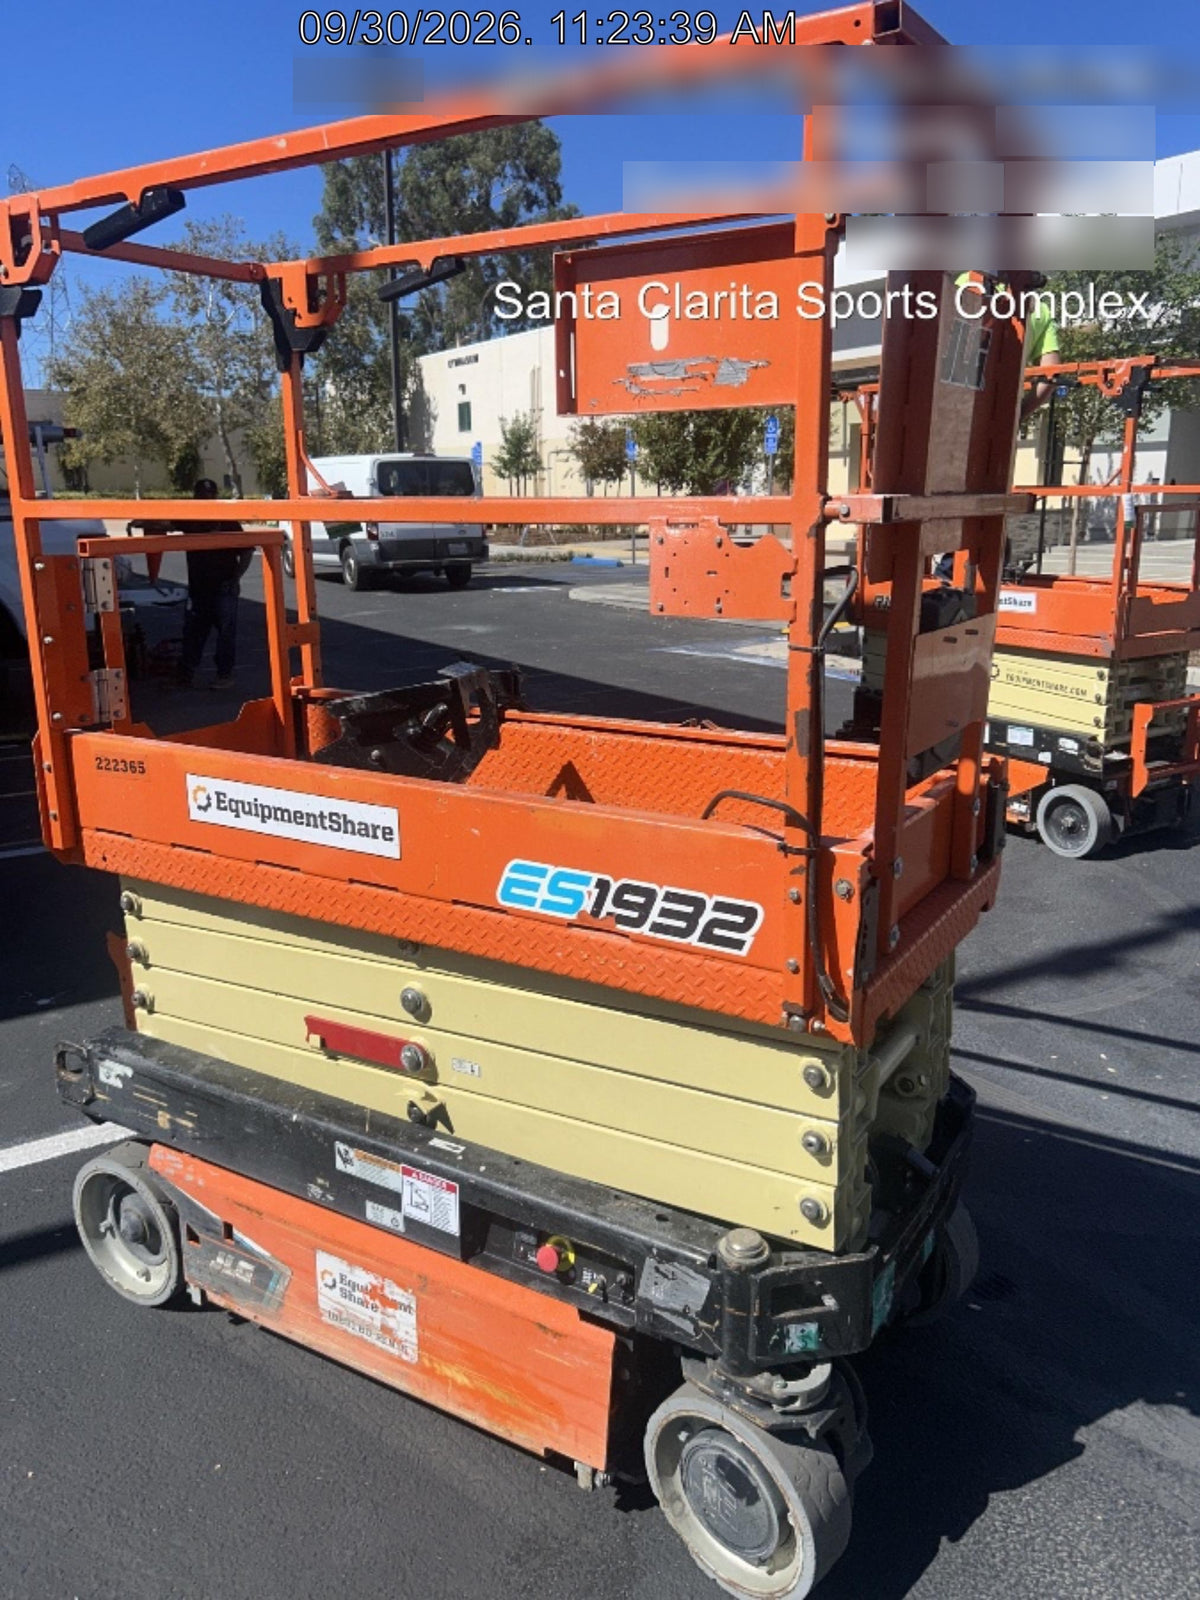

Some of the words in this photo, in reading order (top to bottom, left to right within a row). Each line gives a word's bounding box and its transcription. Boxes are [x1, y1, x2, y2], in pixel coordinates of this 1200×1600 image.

[95, 756, 147, 775] 222365
[214, 789, 396, 843] EquipmentShare
[498, 860, 762, 955] ES1932
